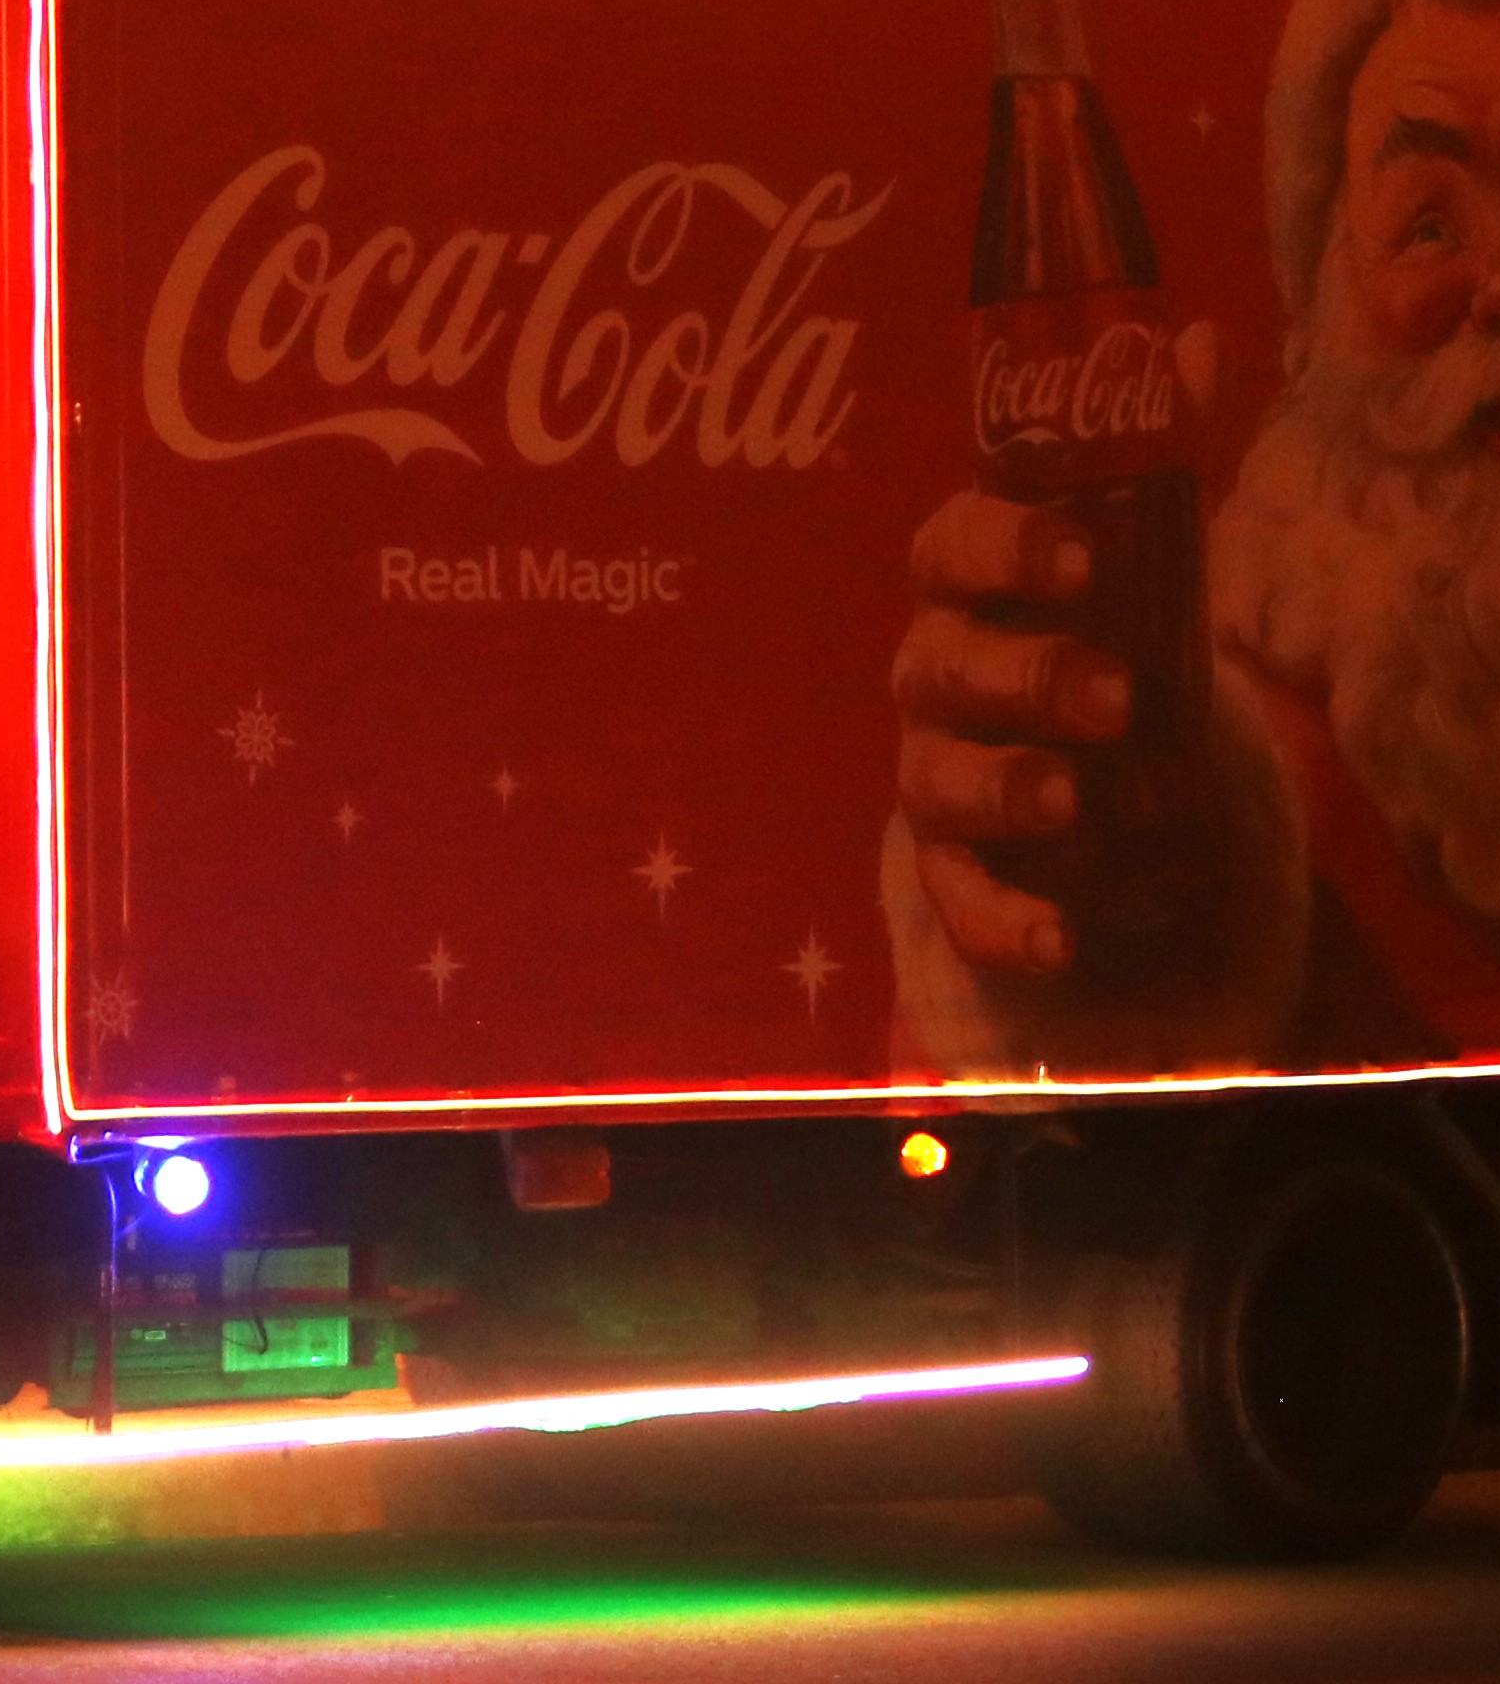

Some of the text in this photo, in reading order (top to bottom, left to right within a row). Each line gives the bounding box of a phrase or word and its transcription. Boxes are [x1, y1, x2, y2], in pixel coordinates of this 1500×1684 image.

[143, 144, 898, 470] Coca-Cola
[975, 321, 1173, 455] Coca-Cola
[380, 546, 682, 614] Real Magic
